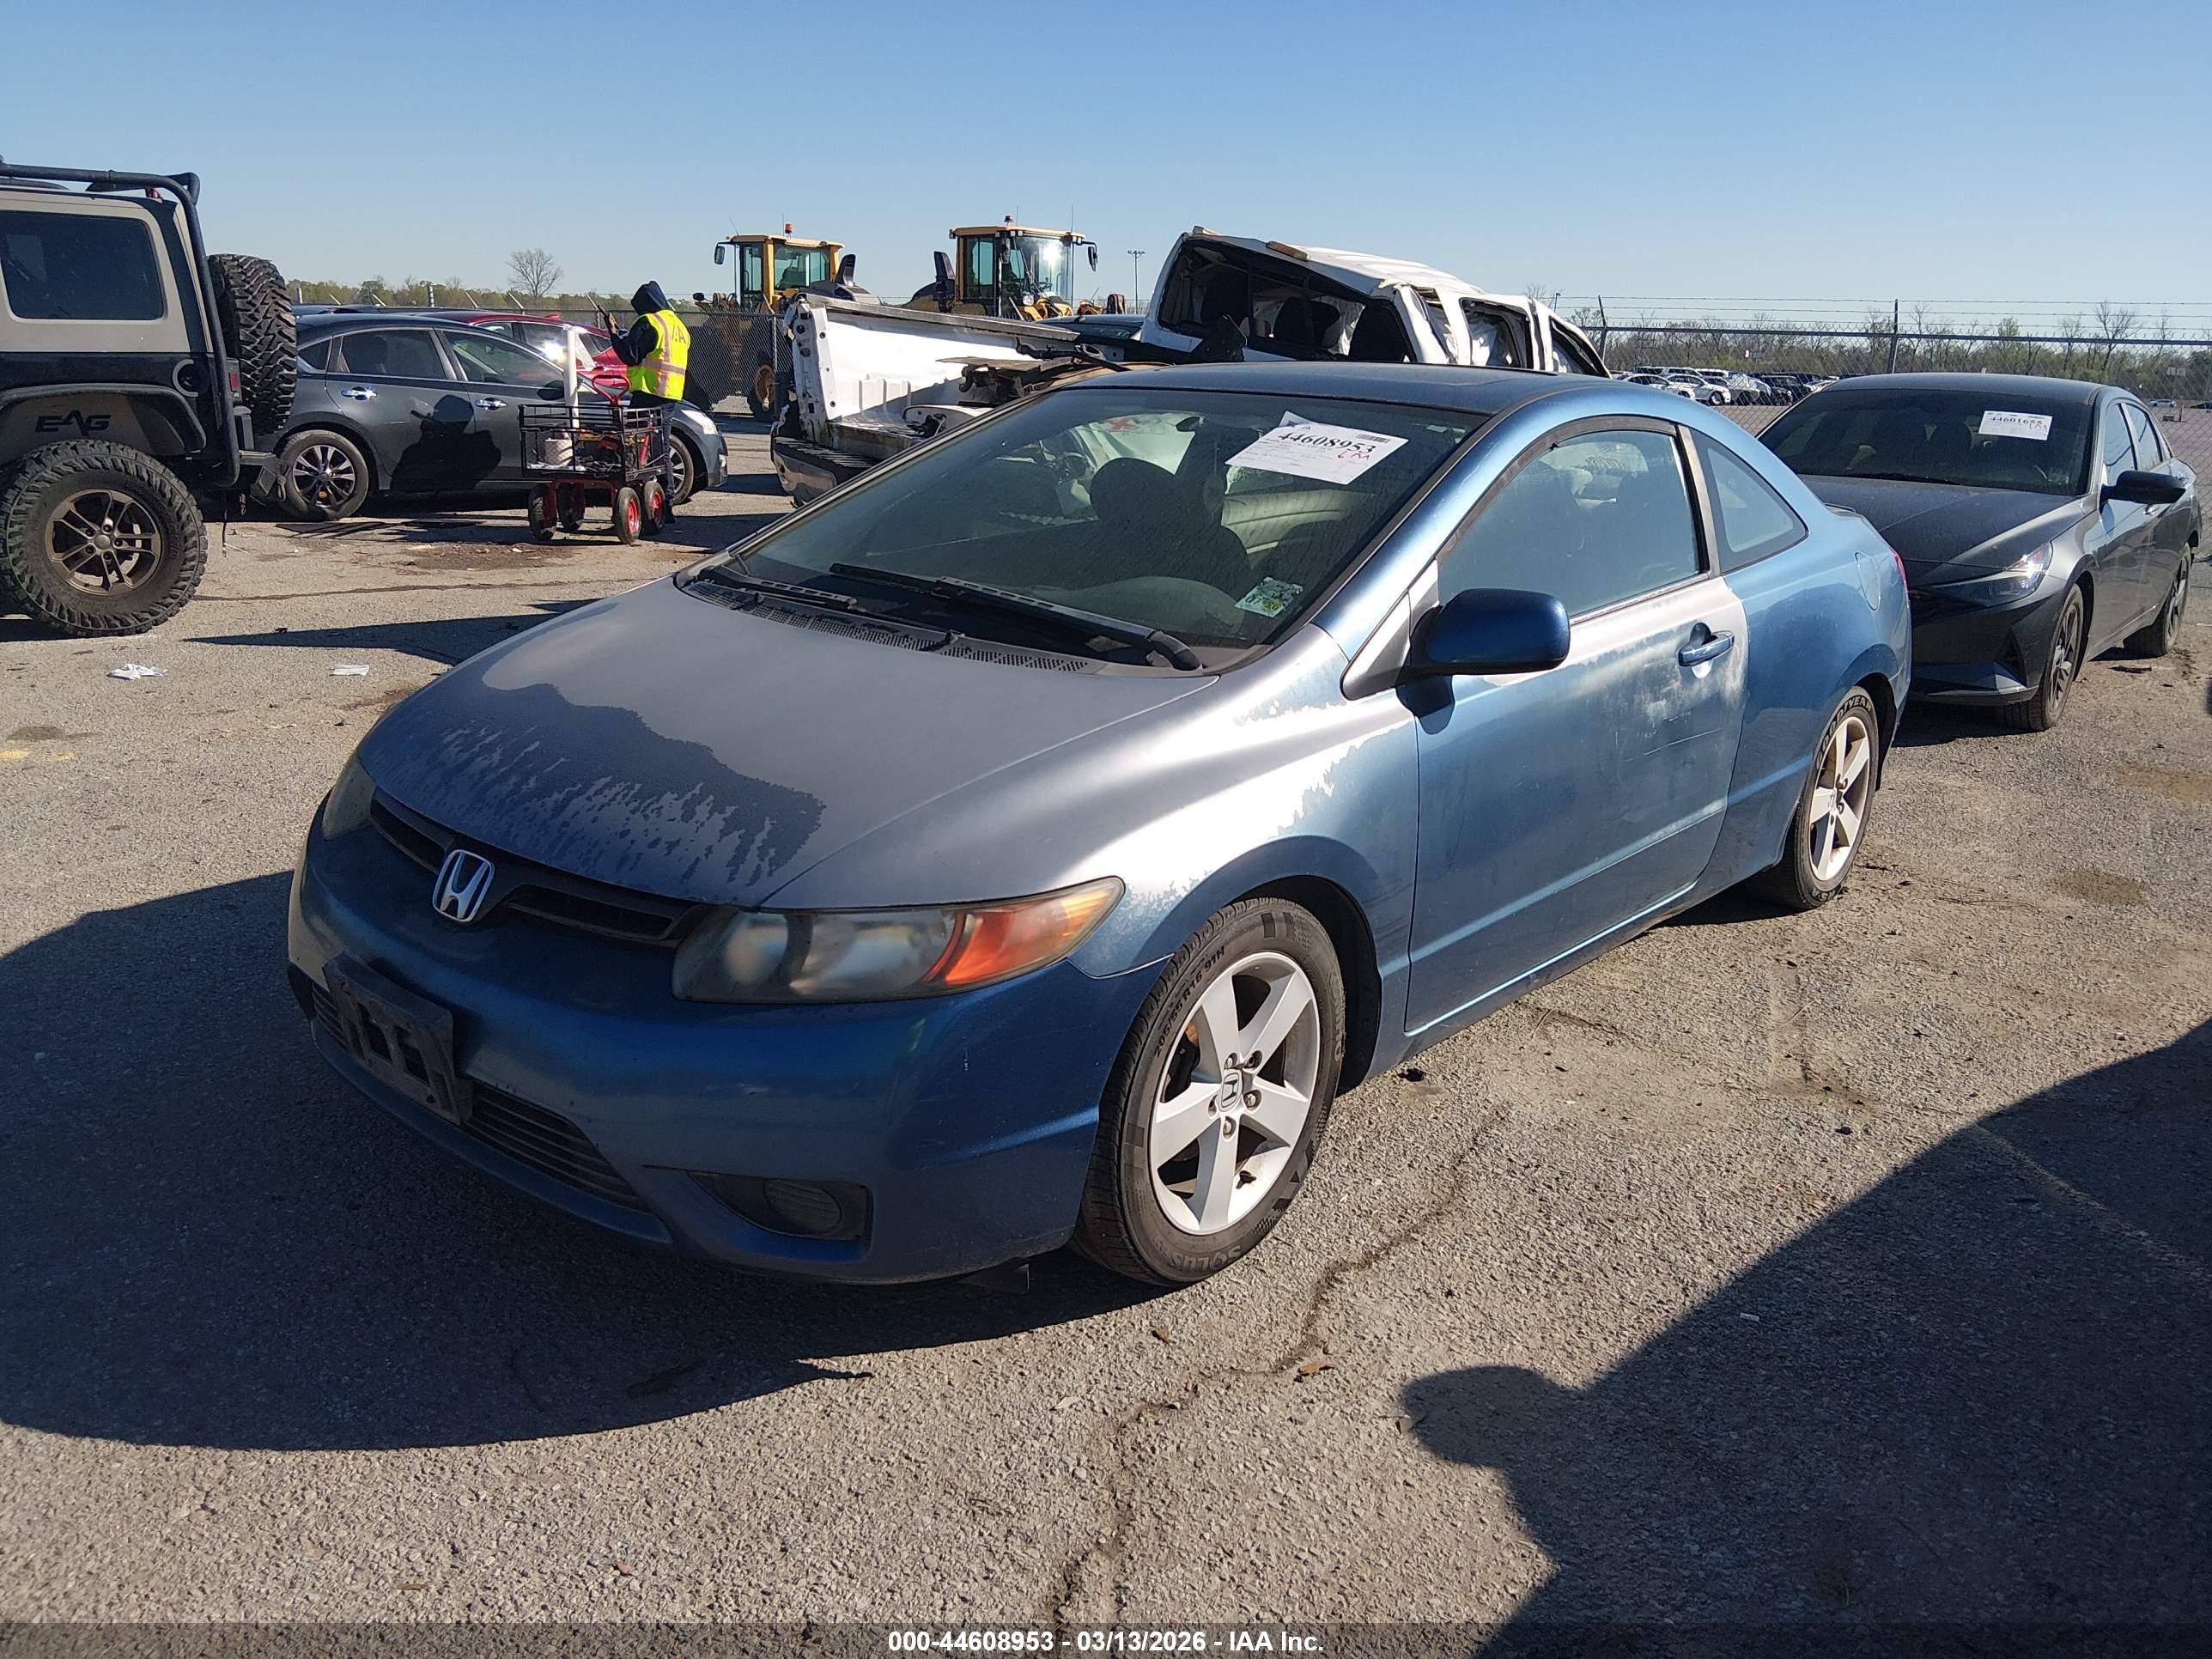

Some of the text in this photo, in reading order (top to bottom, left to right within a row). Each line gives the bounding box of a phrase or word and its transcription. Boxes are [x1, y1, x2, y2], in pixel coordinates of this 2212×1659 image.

[35, 410, 111, 436] EAG
[1278, 432, 1377, 453] 44608953
[1816, 695, 1872, 770] GOODYEAR
[1154, 946, 1225, 1059] 205/55 R16 91H
[1169, 1244, 1242, 1272] SOLUS
